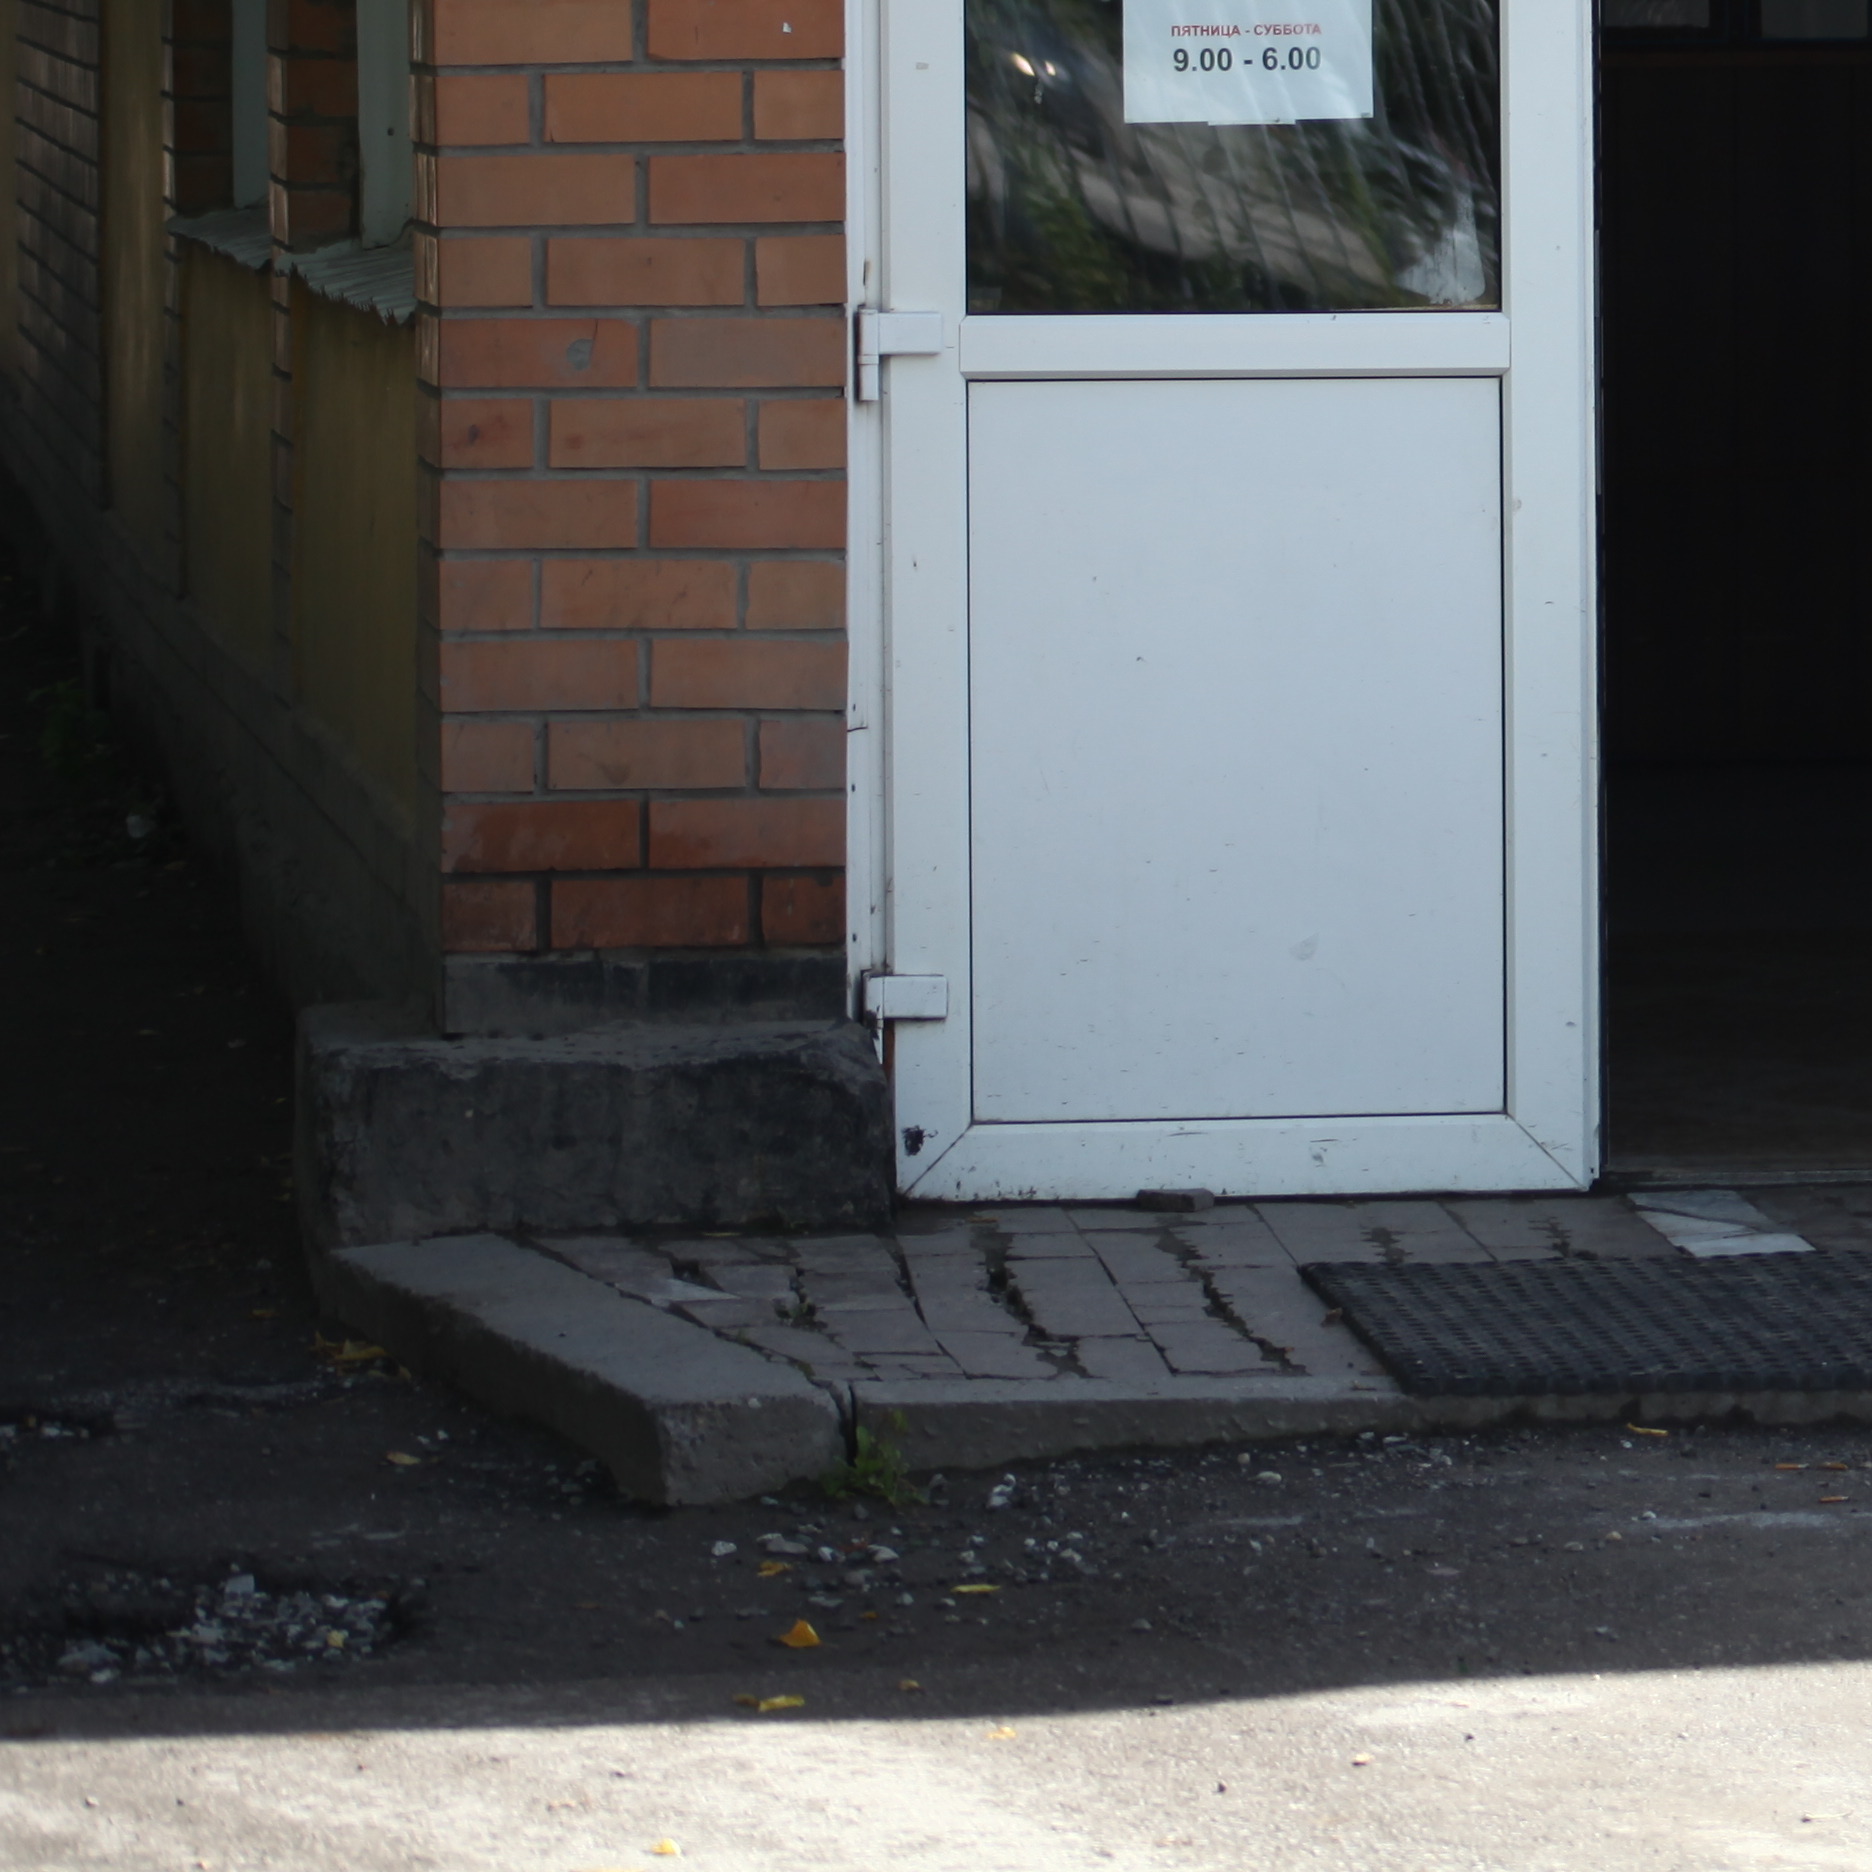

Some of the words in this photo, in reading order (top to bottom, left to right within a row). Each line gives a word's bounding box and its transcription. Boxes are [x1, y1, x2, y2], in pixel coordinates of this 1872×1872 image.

[1170, 24, 1241, 39] ПЯТНИЦА
[1253, 23, 1322, 37] СУББОТА
[1173, 48, 1233, 72] 9.00
[1262, 46, 1322, 71] 6.00
